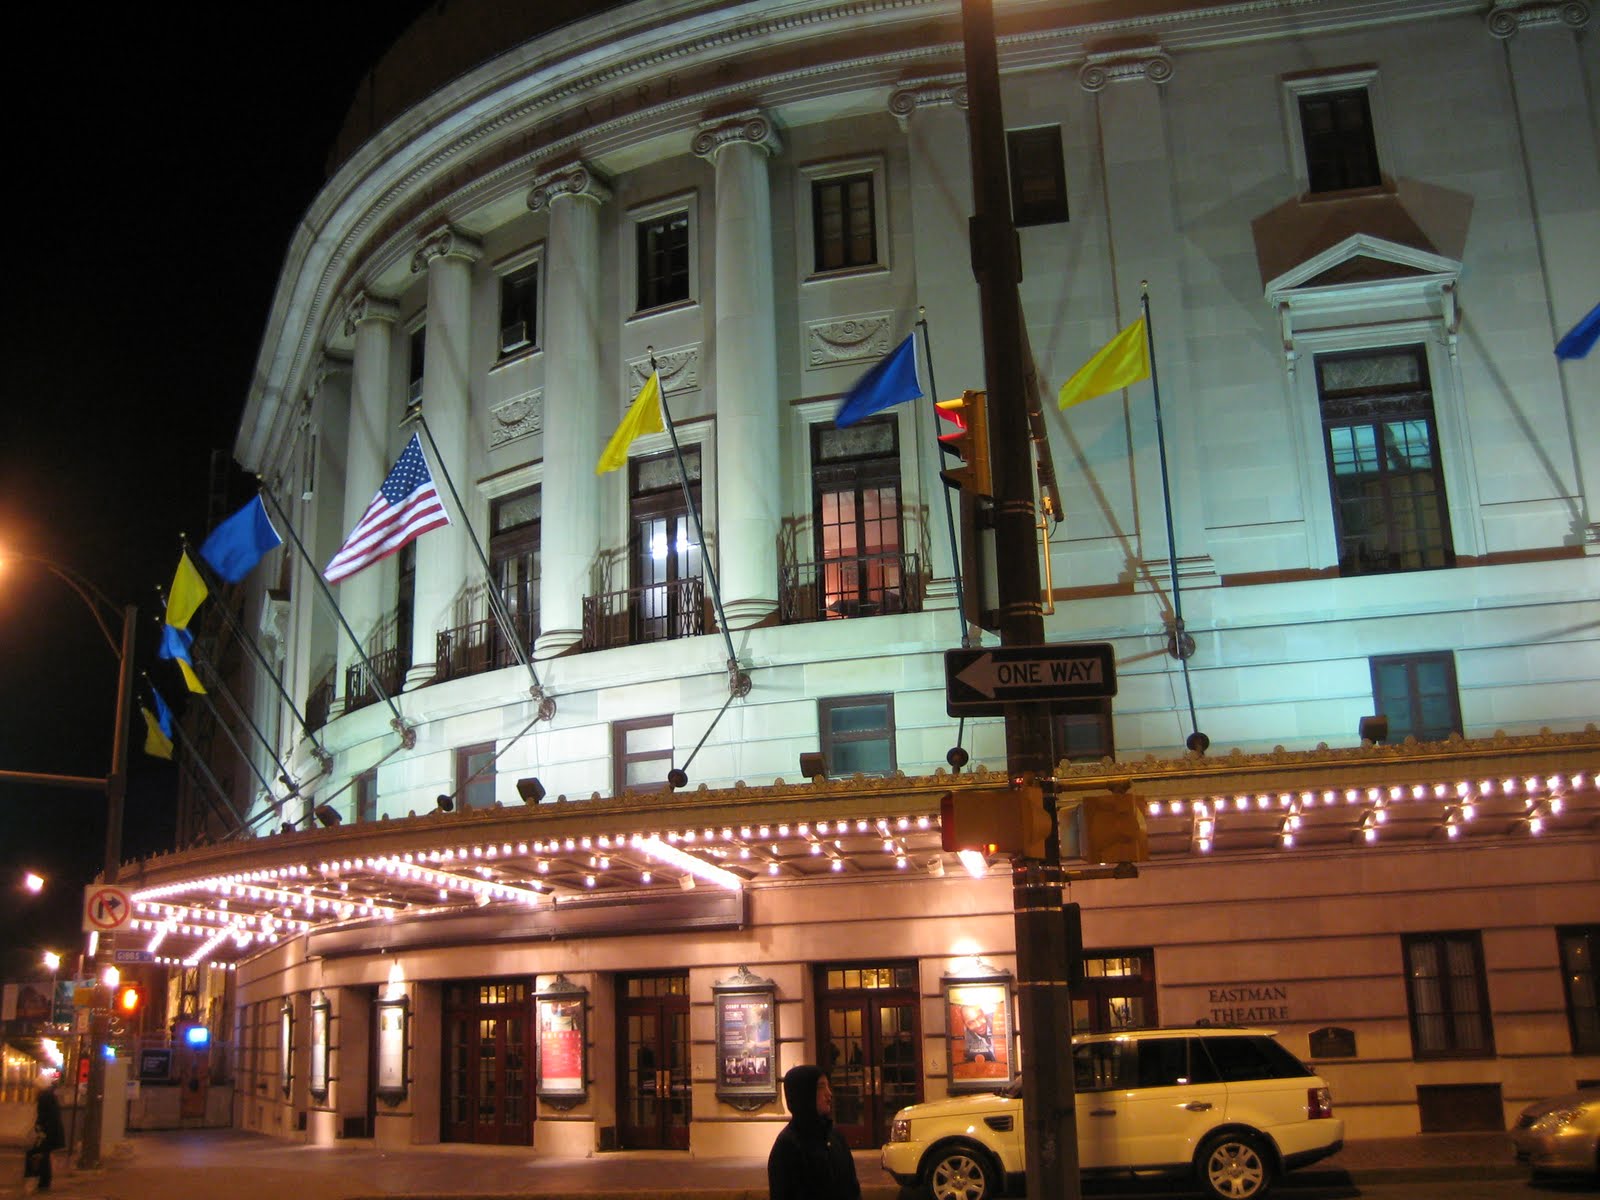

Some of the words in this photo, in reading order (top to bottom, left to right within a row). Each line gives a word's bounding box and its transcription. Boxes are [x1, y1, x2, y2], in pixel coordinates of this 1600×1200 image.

[998, 664, 1042, 684] ONE
[1050, 661, 1095, 682] WAY
[1208, 987, 1287, 1002] EASTMAN
[1210, 1006, 1288, 1021] THEATRE
